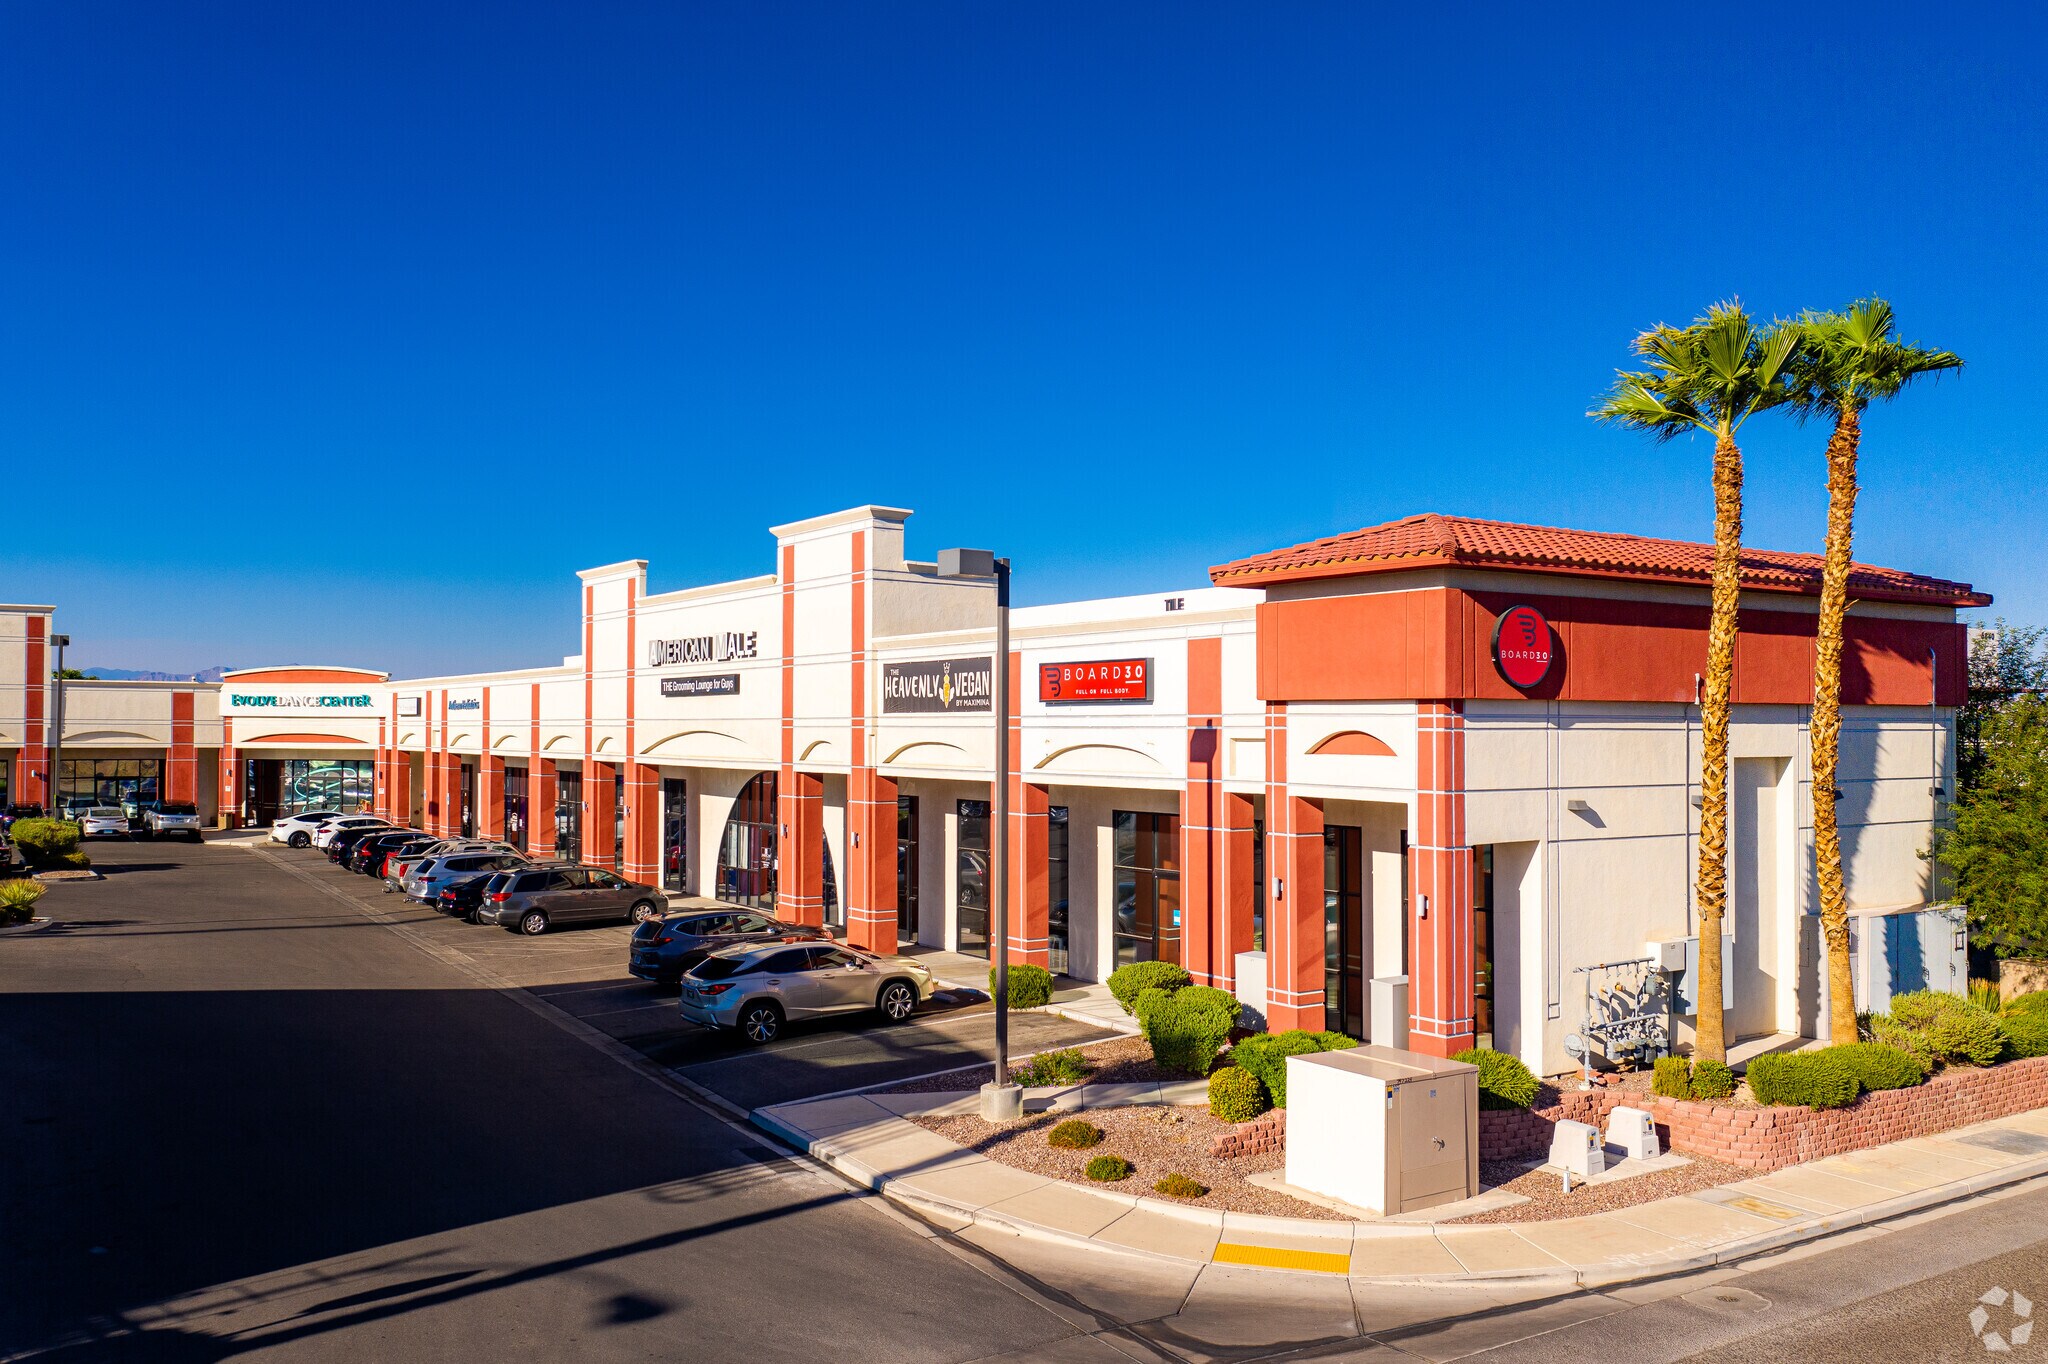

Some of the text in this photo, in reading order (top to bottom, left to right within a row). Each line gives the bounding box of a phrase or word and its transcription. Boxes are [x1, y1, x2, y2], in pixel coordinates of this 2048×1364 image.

[1164, 598, 1185, 611] TILE
[648, 631, 758, 667] AMERICAN MALE
[662, 677, 734, 693] THE Grooming Lounge for Guys
[885, 671, 990, 699] HEAVENLY VEGAN
[955, 698, 990, 707] BY MAXIMINA
